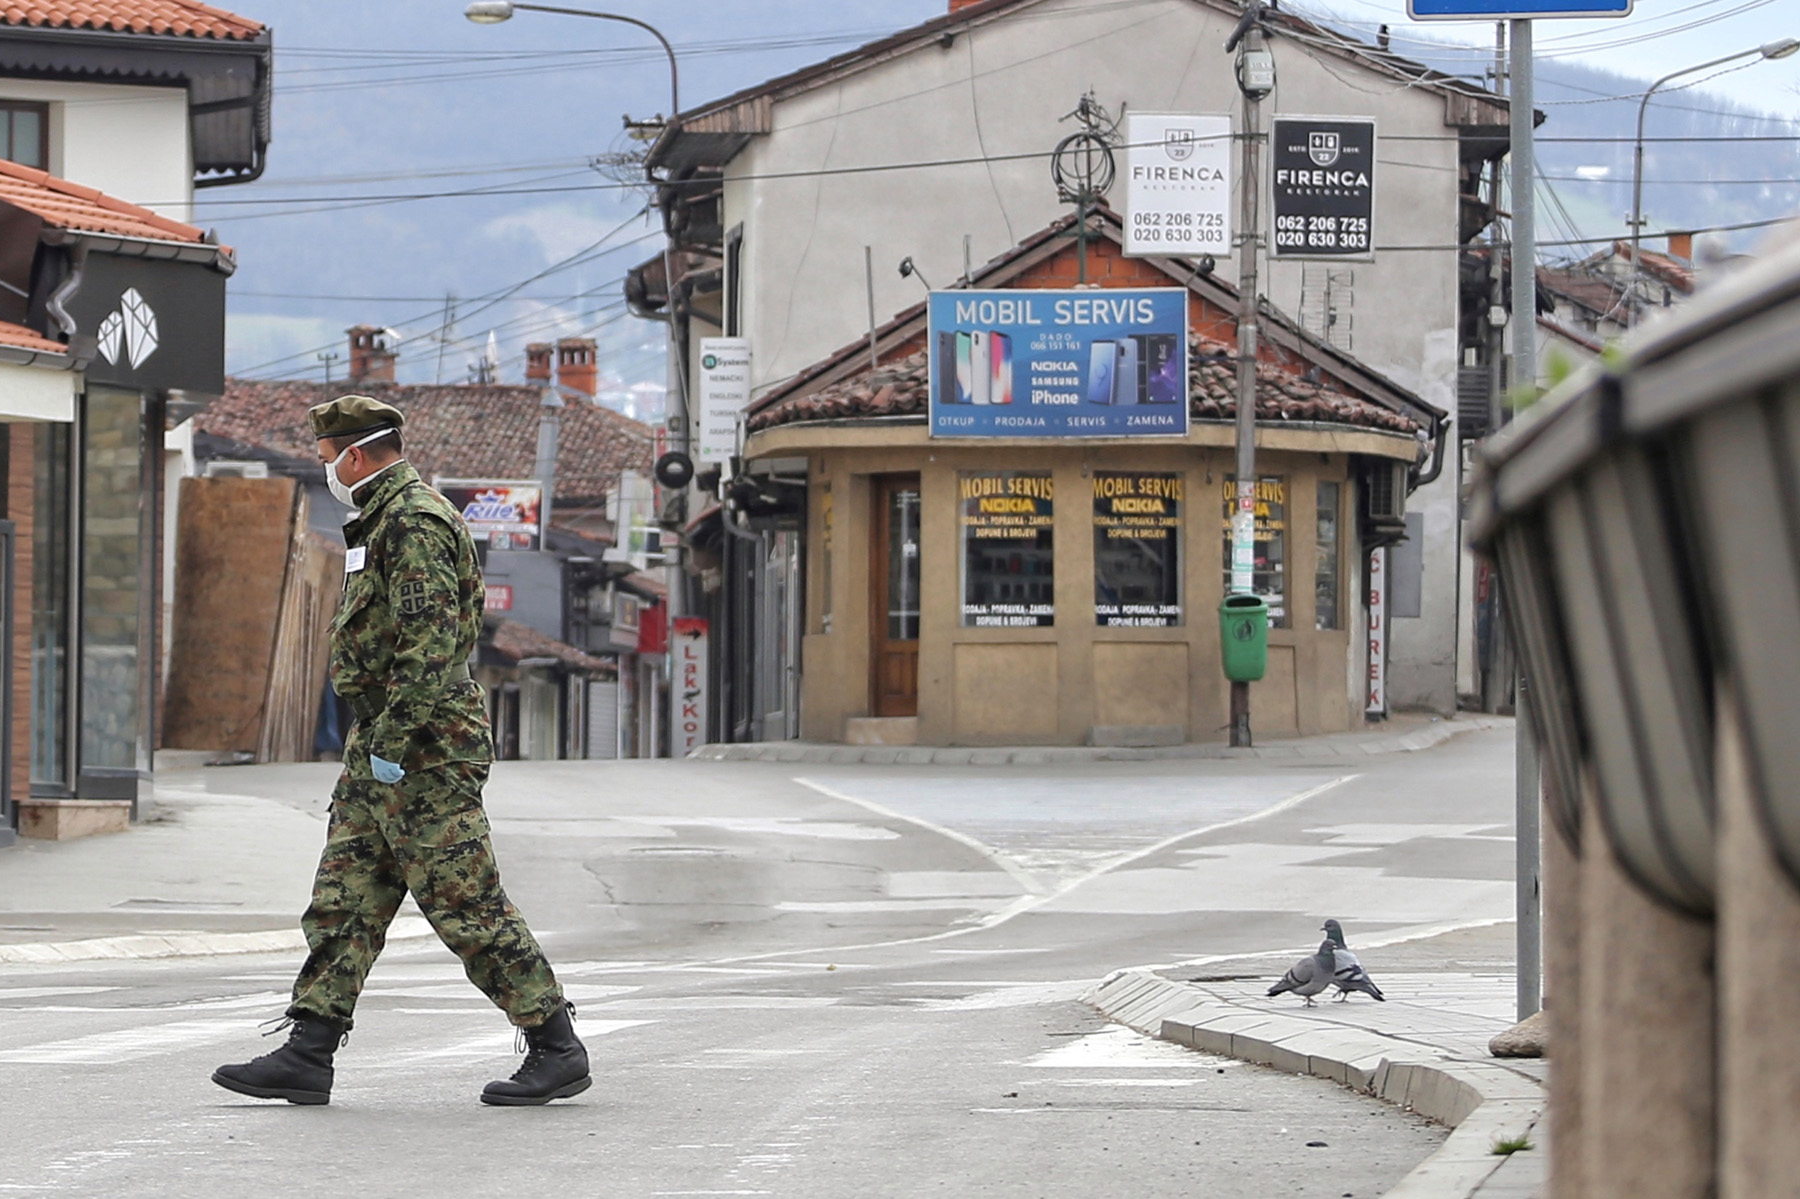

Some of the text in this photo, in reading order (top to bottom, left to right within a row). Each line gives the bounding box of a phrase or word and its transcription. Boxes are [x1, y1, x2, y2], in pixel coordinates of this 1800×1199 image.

[1319, 153, 1330, 161] 22
[1133, 166, 1224, 182] FIRENCA
[1276, 170, 1369, 187] FIRENCA
[1287, 188, 1360, 196] RESTORAN
[1134, 213, 1223, 227] 062 206 725
[1277, 216, 1367, 230] 062 206 725
[1134, 228, 1223, 242] 020 630 303
[1277, 232, 1367, 247] 020 630 303
[956, 298, 1155, 325] MOBIL SERVIS
[1031, 361, 1078, 371] NOKIA
[1031, 377, 1079, 386] SAMSUNG
[1032, 390, 1078, 405] iPhone
[939, 415, 1174, 427] OTKUP PRODAJA SERVIS ZAMENA
[961, 478, 1053, 500] MOBIL SERVIS
[1093, 478, 1183, 500] MOBIL SERVIS
[979, 499, 1035, 513] NOKIA
[1112, 499, 1165, 513] NOKIA
[1368, 590, 1380, 705] BUREK
[683, 704, 698, 753] Kor
